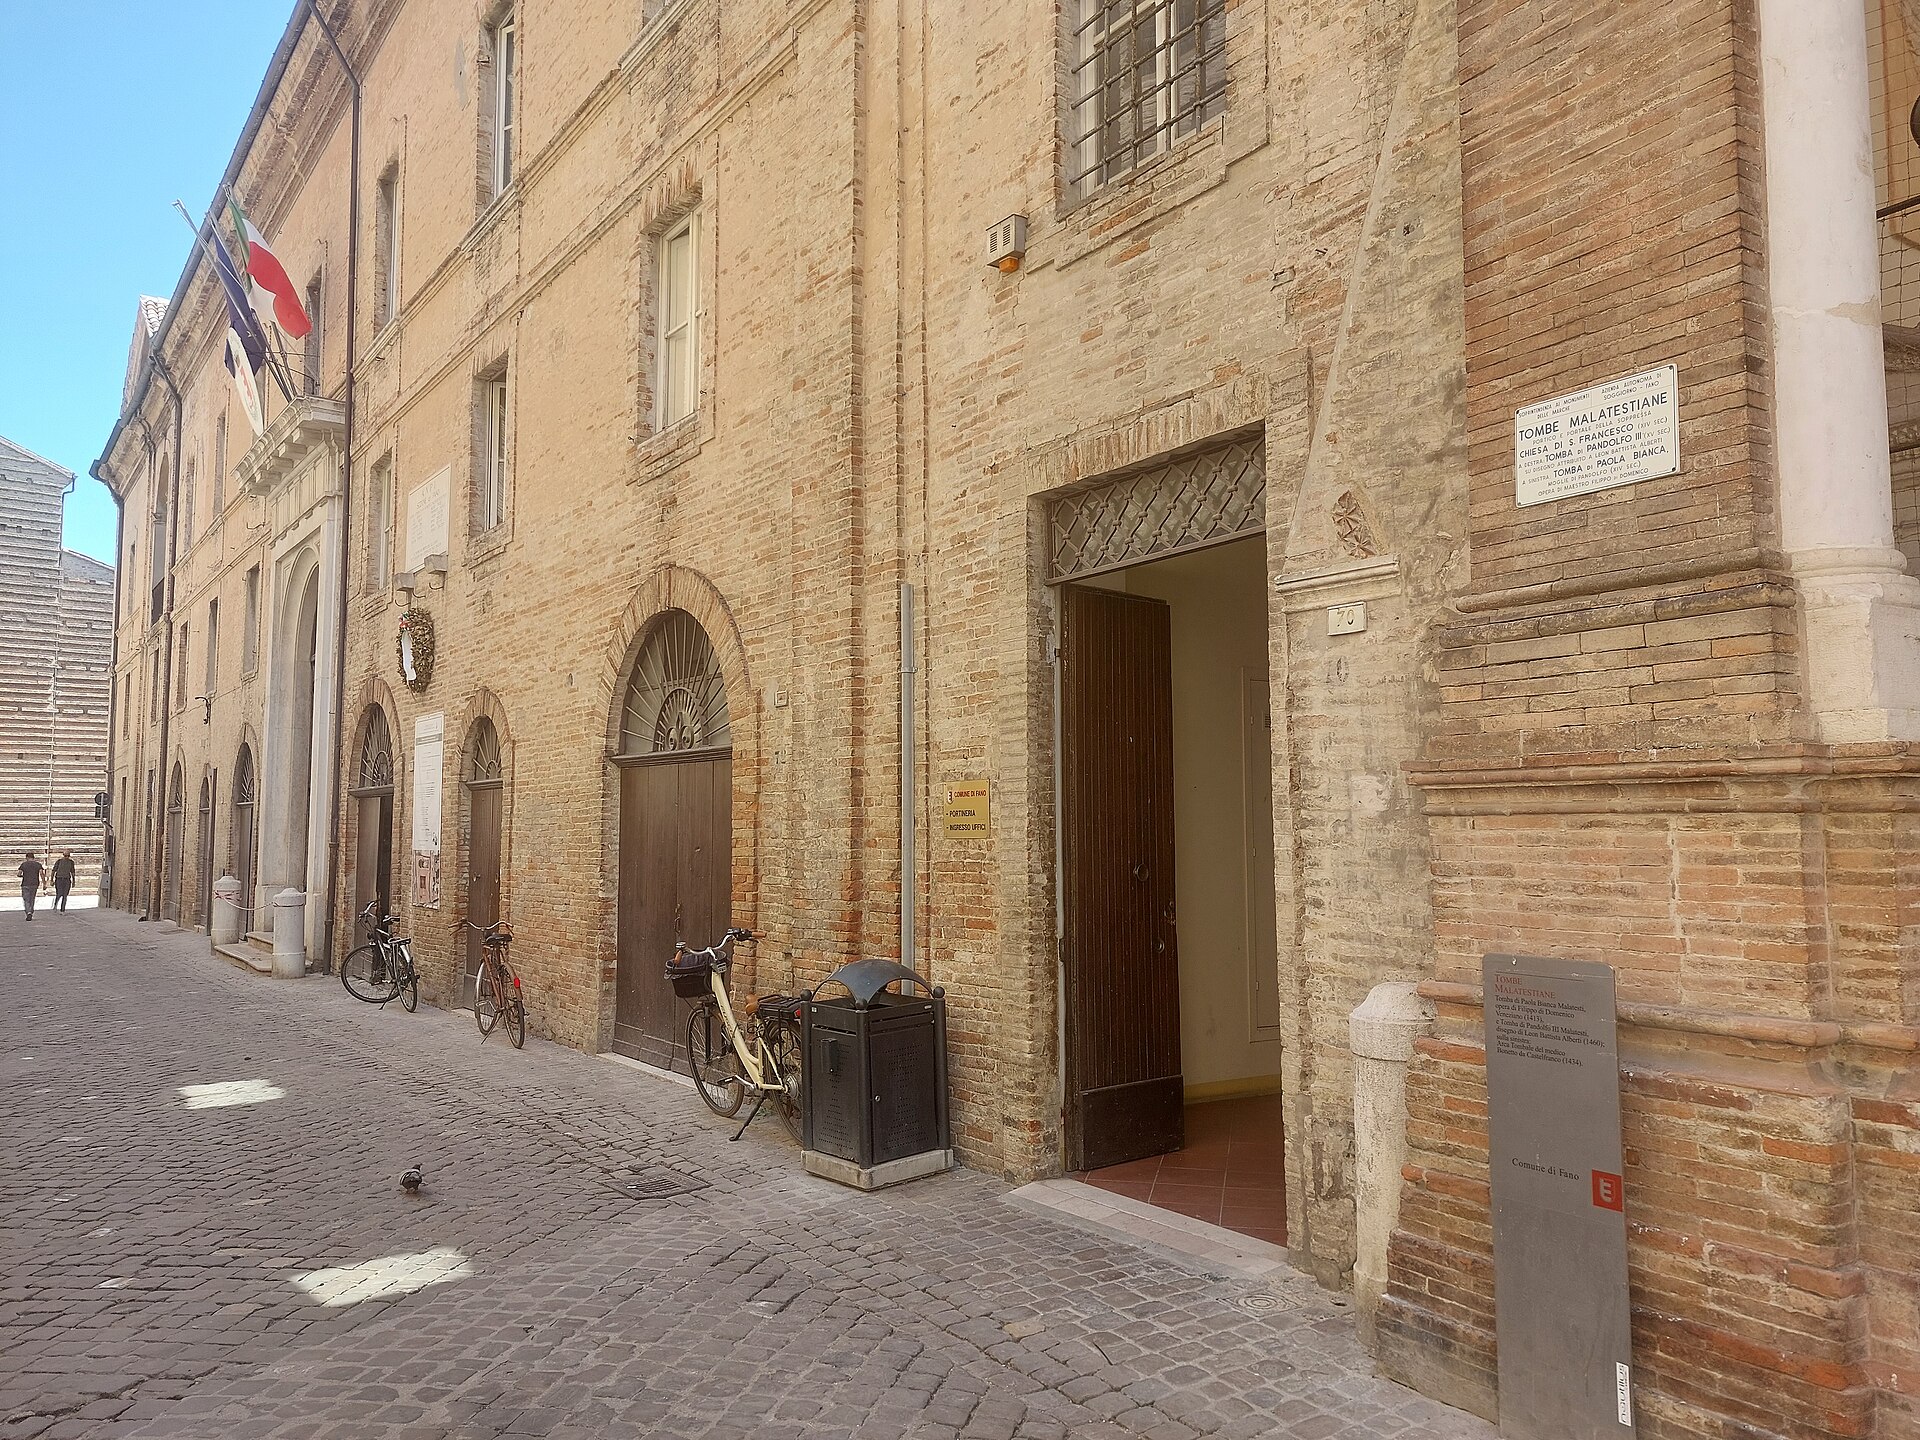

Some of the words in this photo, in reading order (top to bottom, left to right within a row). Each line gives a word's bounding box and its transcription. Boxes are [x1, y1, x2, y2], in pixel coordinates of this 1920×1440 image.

[1602, 384, 1619, 394] AZIENDA
[1624, 376, 1652, 388] AUTONOMA
[1604, 387, 1637, 400] SOGGIORNO
[1646, 380, 1660, 389] FANO
[1519, 420, 1559, 441] TOMBE
[1570, 392, 1668, 428] MALATESTIANE
[1532, 435, 1556, 445] PORTICO
[1567, 426, 1591, 436] PORTALE
[1596, 421, 1613, 429] DELLA
[1618, 410, 1652, 424] SOPPRESSA
[1520, 445, 1548, 458] CHIESA
[1554, 441, 1562, 450] DI
[1579, 424, 1633, 443] FRANCESCO
[1545, 449, 1573, 462] TOMBA
[1587, 435, 1632, 452] PANDOLFO
[1533, 464, 1555, 473] DISEGNO
[1557, 456, 1586, 467] ATTRIBUITO
[1595, 450, 1609, 458] LEON
[1612, 444, 1636, 454] BATTISTA
[1640, 438, 1662, 447] ALBERTI
[1554, 465, 1583, 478] TOMBA
[1597, 455, 1625, 468] PAOLA
[1538, 488, 1555, 496] OPERA
[1564, 481, 1589, 490] MAESTRO
[1591, 476, 1611, 484] FILIPPO
[1620, 468, 1648, 478] DOMENICO
[1548, 478, 1568, 486] MOGLIE
[1579, 469, 1608, 480] PANDOLFO
[1495, 984, 1556, 999] MALATESTIANE
[1518, 1005, 1537, 1014] Filippo
[1546, 1009, 1575, 1018] Domenico
[1538, 1000, 1556, 1008] Bianca
[1496, 1010, 1523, 1019] Veneziano
[1496, 1026, 1516, 1034] disegno
[1540, 1032, 1560, 1040] Battista
[1526, 1023, 1551, 1031] Pandolfo
[1511, 1042, 1534, 1051] Tombale
[1545, 1048, 1565, 1056] medico
[1527, 1052, 1561, 1062] Castelfranco
[1511, 1157, 1545, 1173] Comune
[1547, 1166, 1556, 1176] di
[1559, 1169, 1580, 1180] Fano
